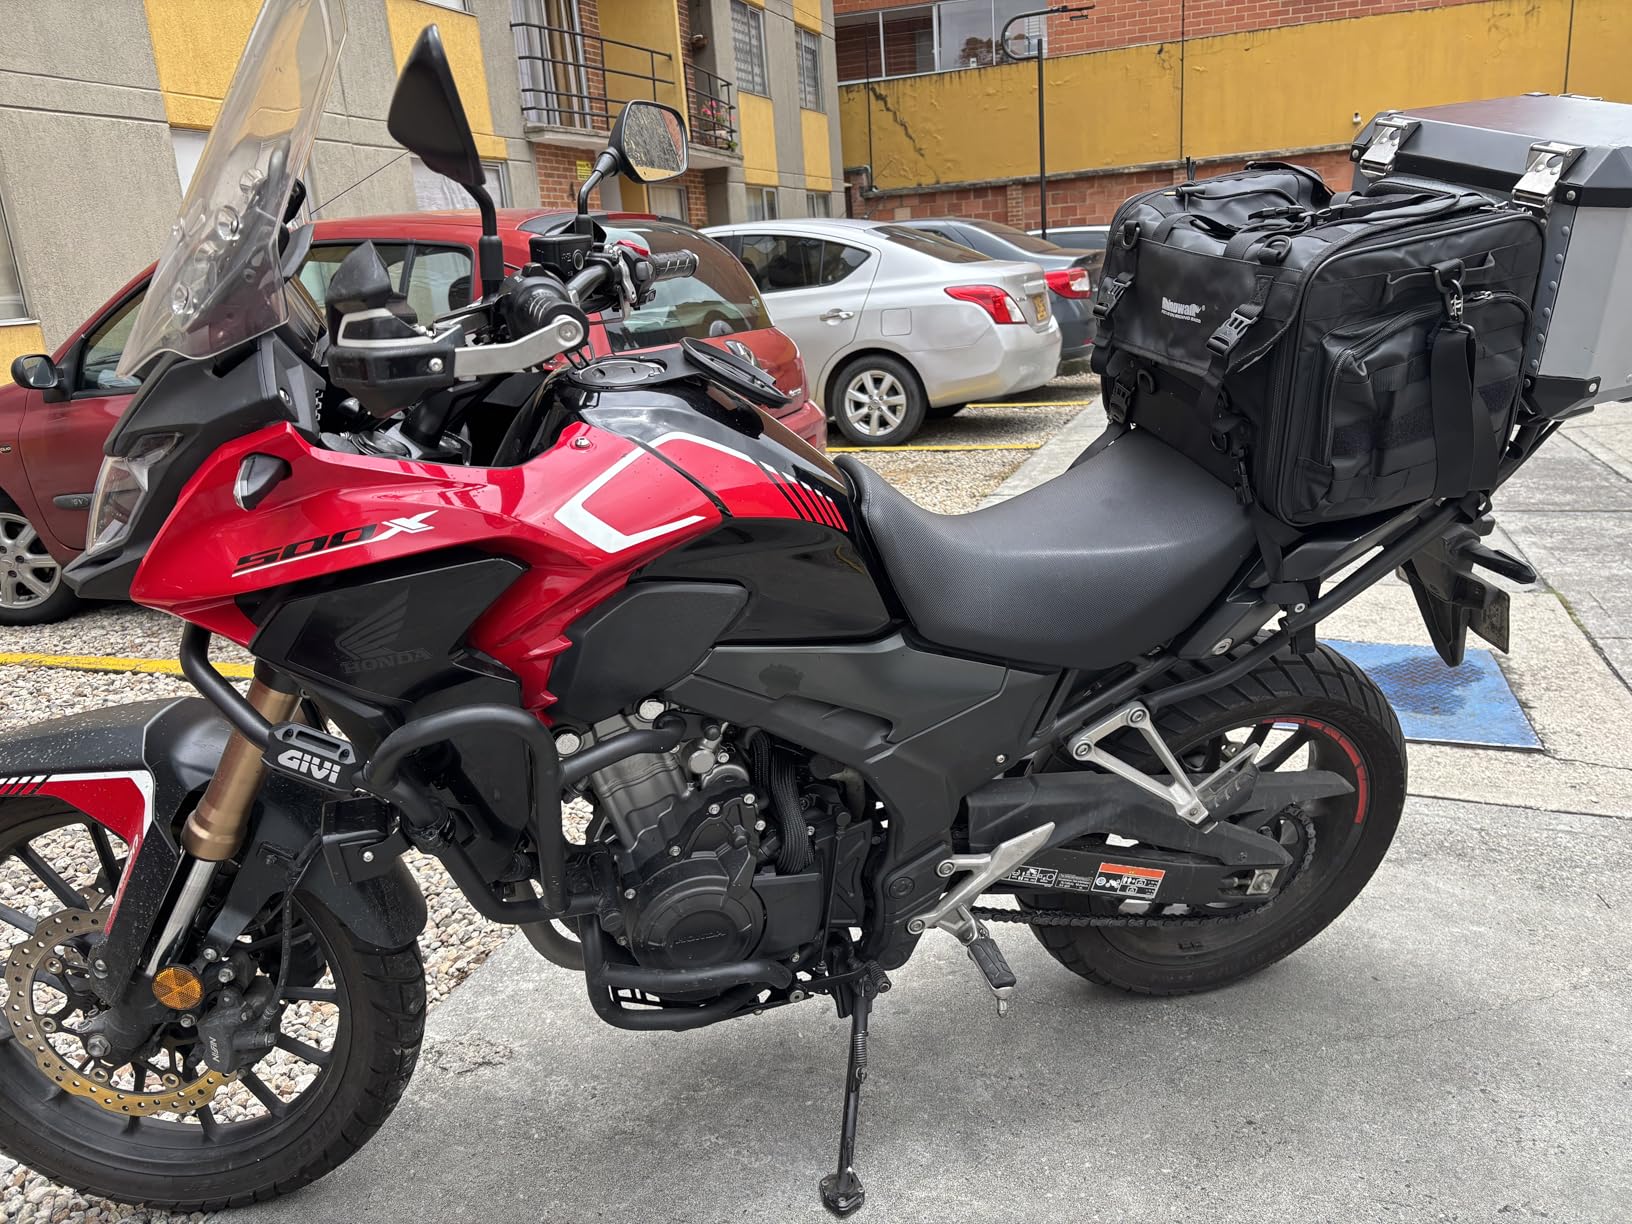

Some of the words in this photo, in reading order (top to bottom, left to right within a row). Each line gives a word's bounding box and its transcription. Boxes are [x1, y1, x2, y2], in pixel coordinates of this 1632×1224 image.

[232, 510, 439, 578] 500X
[341, 648, 432, 674] HONDA
[277, 749, 341, 784] GIVI
